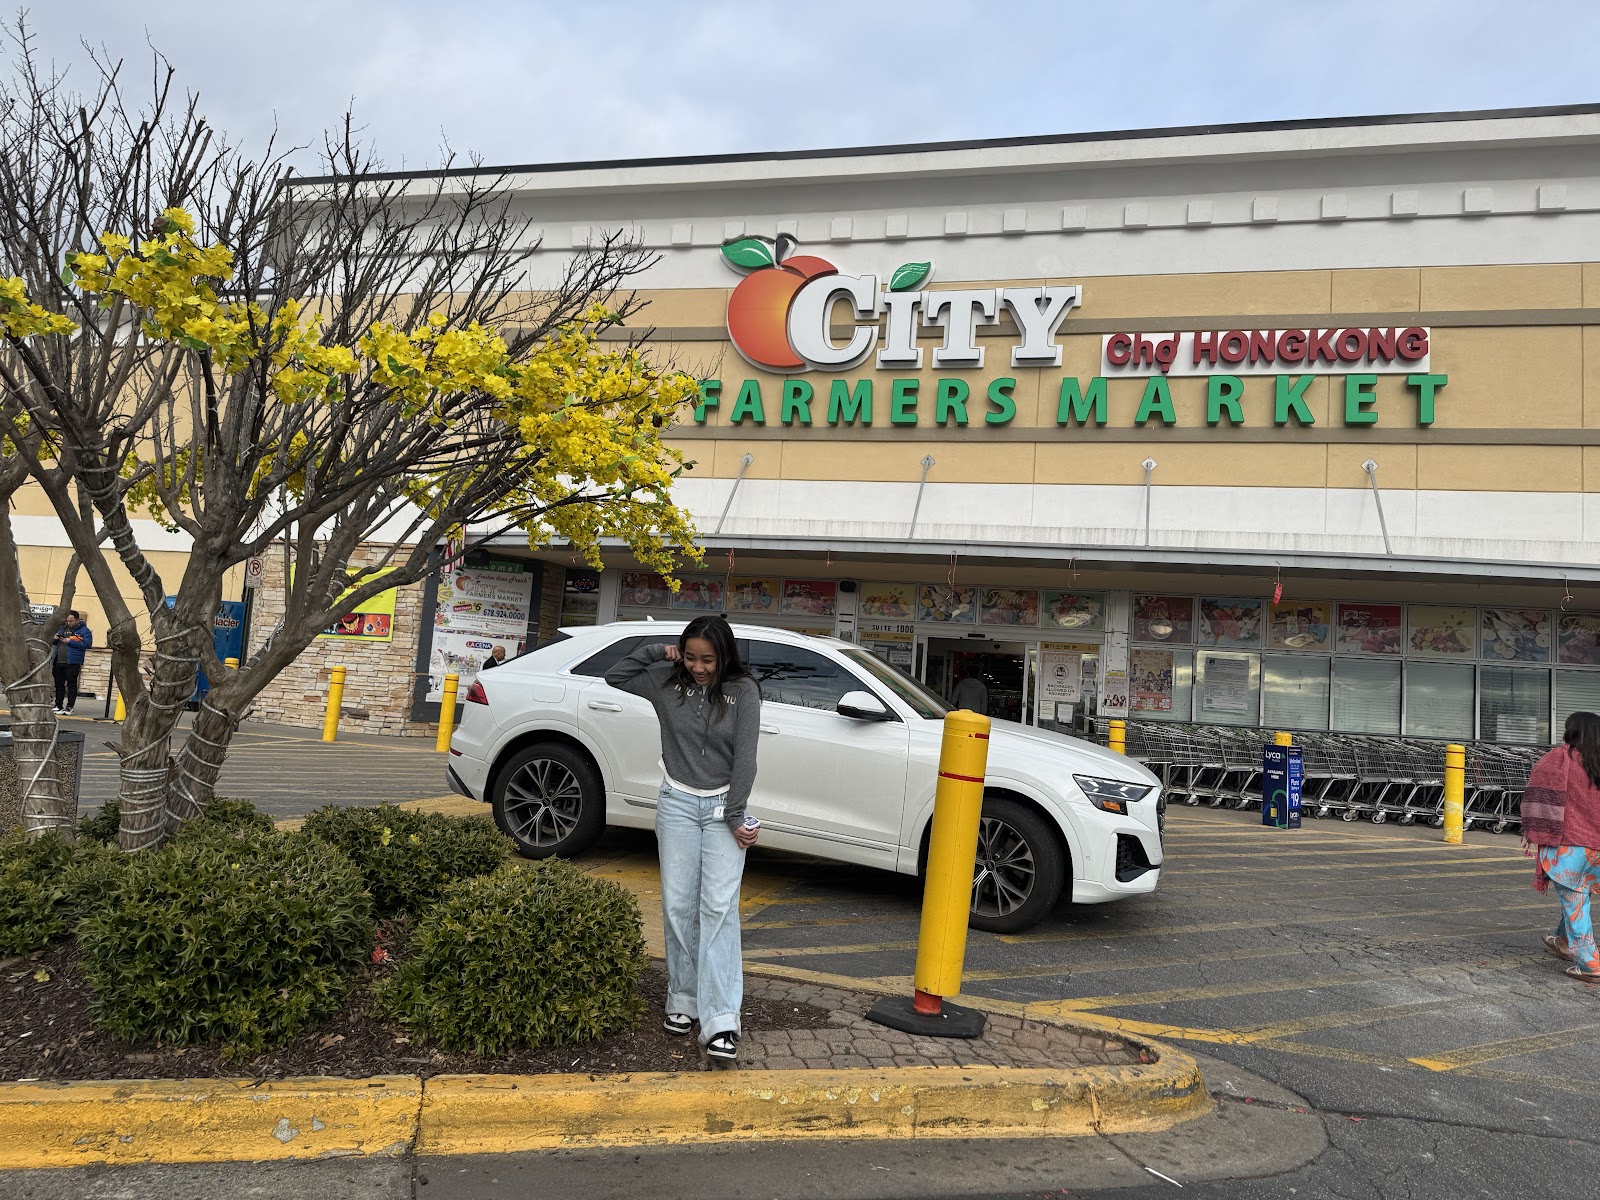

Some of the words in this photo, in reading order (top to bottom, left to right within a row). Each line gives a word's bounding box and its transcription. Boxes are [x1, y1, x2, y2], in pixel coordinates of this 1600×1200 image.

[1192, 327, 1429, 365] HONGKONG
[693, 377, 1018, 425] FARMERS
[1057, 374, 1448, 425] MARKET
[466, 591, 496, 599] FARMERS
[497, 595, 523, 603] MARKET
[483, 608, 526, 620] 678.924.0000
[214, 616, 240, 628] lacier
[896, 625, 914, 633] 1000
[1045, 654, 1078, 662] NOTICE
[1266, 750, 1280, 759] Lyca
